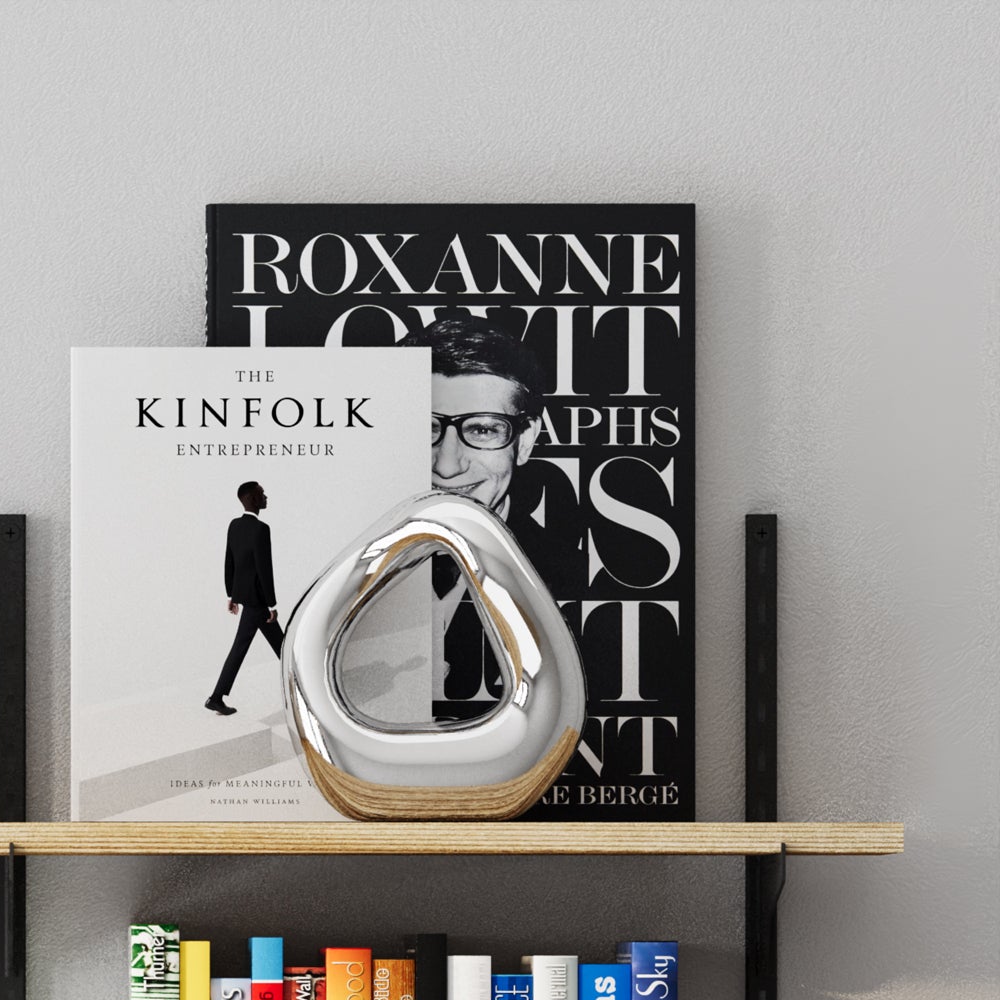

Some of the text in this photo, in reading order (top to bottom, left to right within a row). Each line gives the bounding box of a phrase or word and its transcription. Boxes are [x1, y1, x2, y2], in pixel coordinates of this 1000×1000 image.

[232, 233, 681, 295] ROXANNE
[235, 370, 275, 382] THE
[136, 397, 374, 428] KINFOLK
[176, 444, 335, 456] ENTREPRENEUR
[170, 780, 204, 788] IDEAS
[208, 779, 221, 789] for
[226, 780, 303, 788] MEANINGFUL
[577, 782, 679, 805] BERGÉ
[635, 955, 676, 999] Sky
